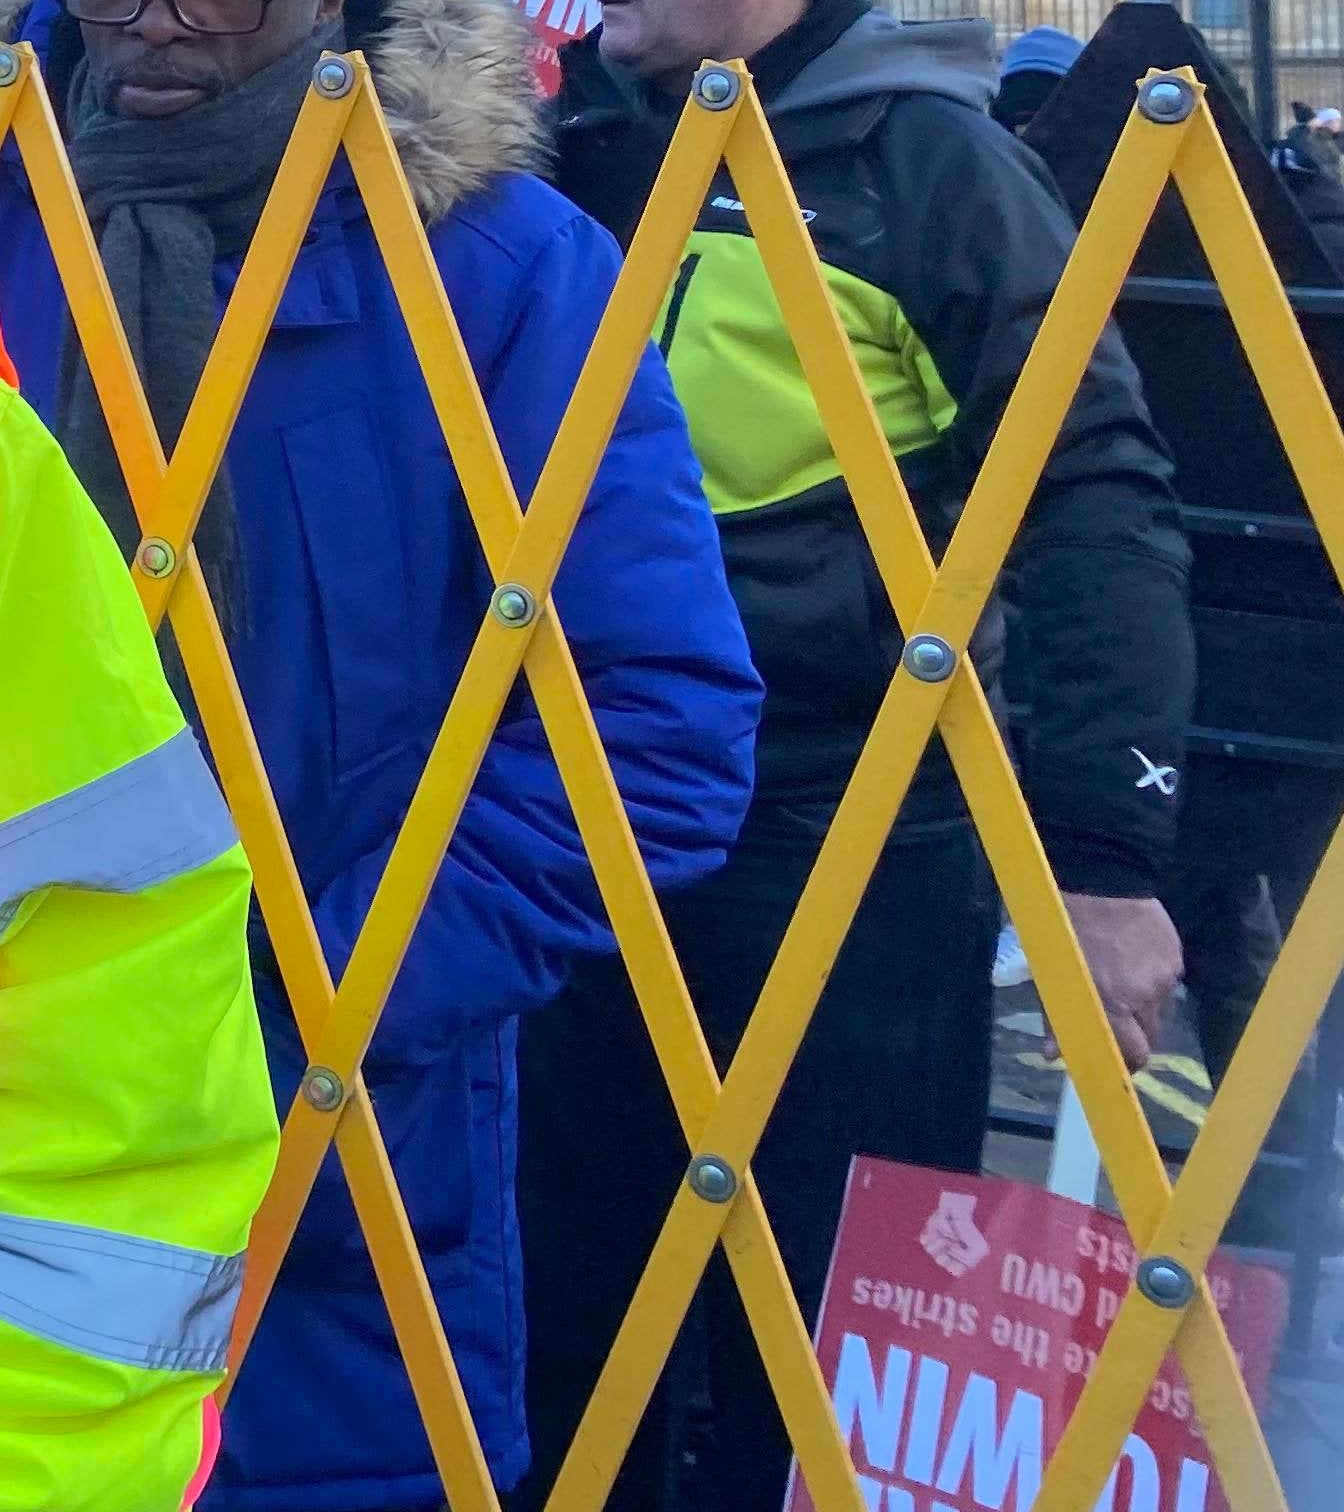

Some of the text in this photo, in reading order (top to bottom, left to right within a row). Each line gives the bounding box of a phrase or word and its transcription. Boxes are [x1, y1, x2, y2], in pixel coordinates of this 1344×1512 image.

[852, 1276, 979, 1337] strikes
[1000, 1254, 1086, 1318] CWU
[991, 1318, 1050, 1368] the
[834, 1333, 1044, 1512] WIN
